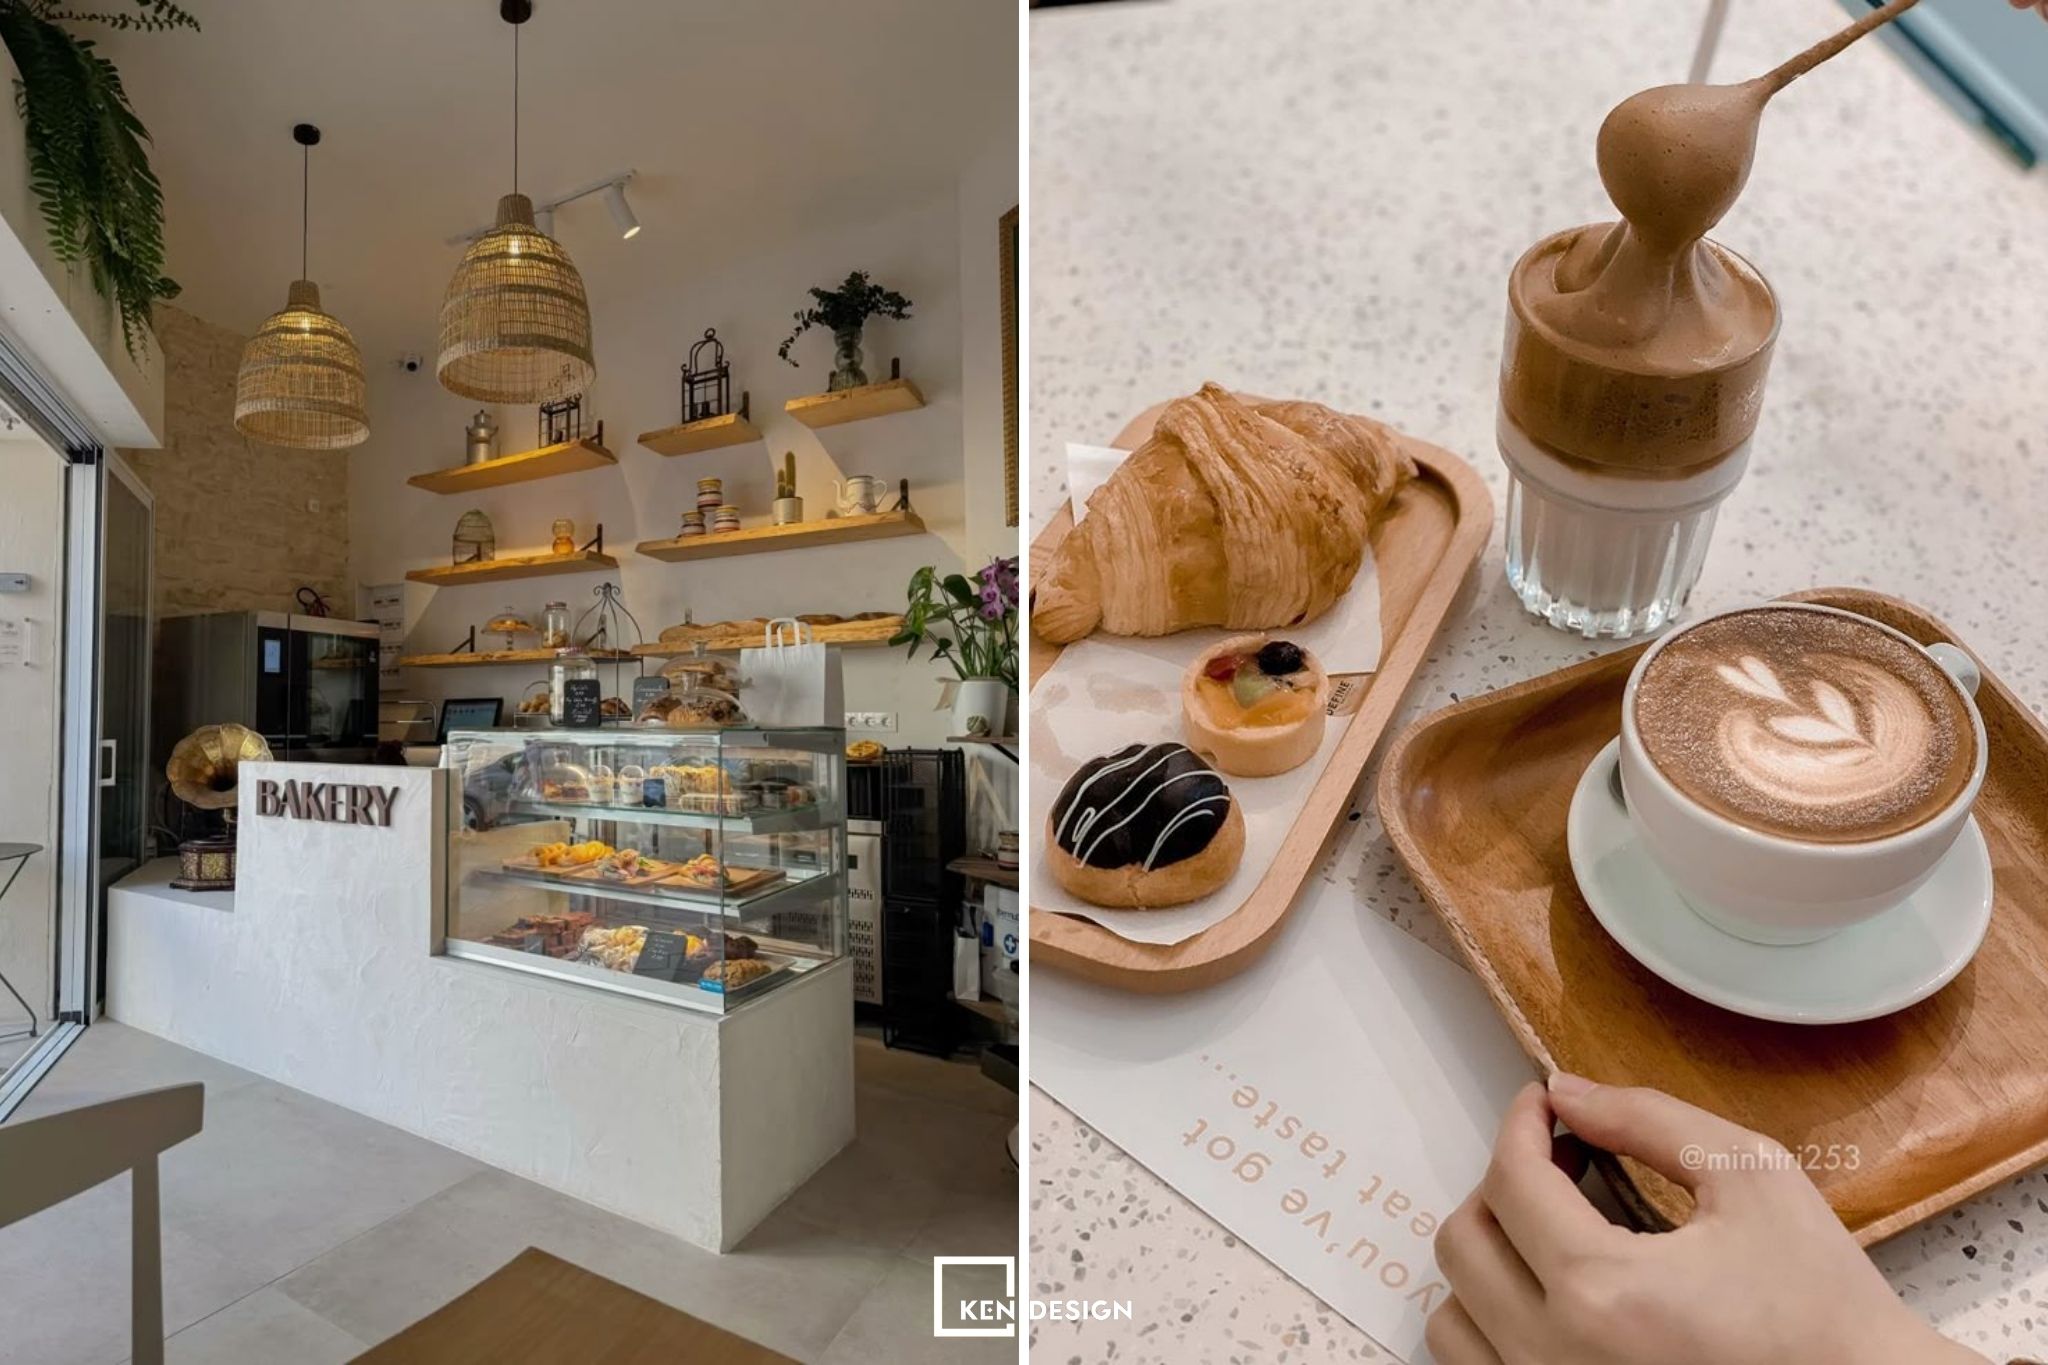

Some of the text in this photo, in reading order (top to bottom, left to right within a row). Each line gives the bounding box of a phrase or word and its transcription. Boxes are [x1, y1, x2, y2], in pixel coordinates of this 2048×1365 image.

[256, 778, 400, 827] BAKERY
[1181, 1118, 1445, 1314] you've got
[1357, 1174, 1438, 1238] eat
